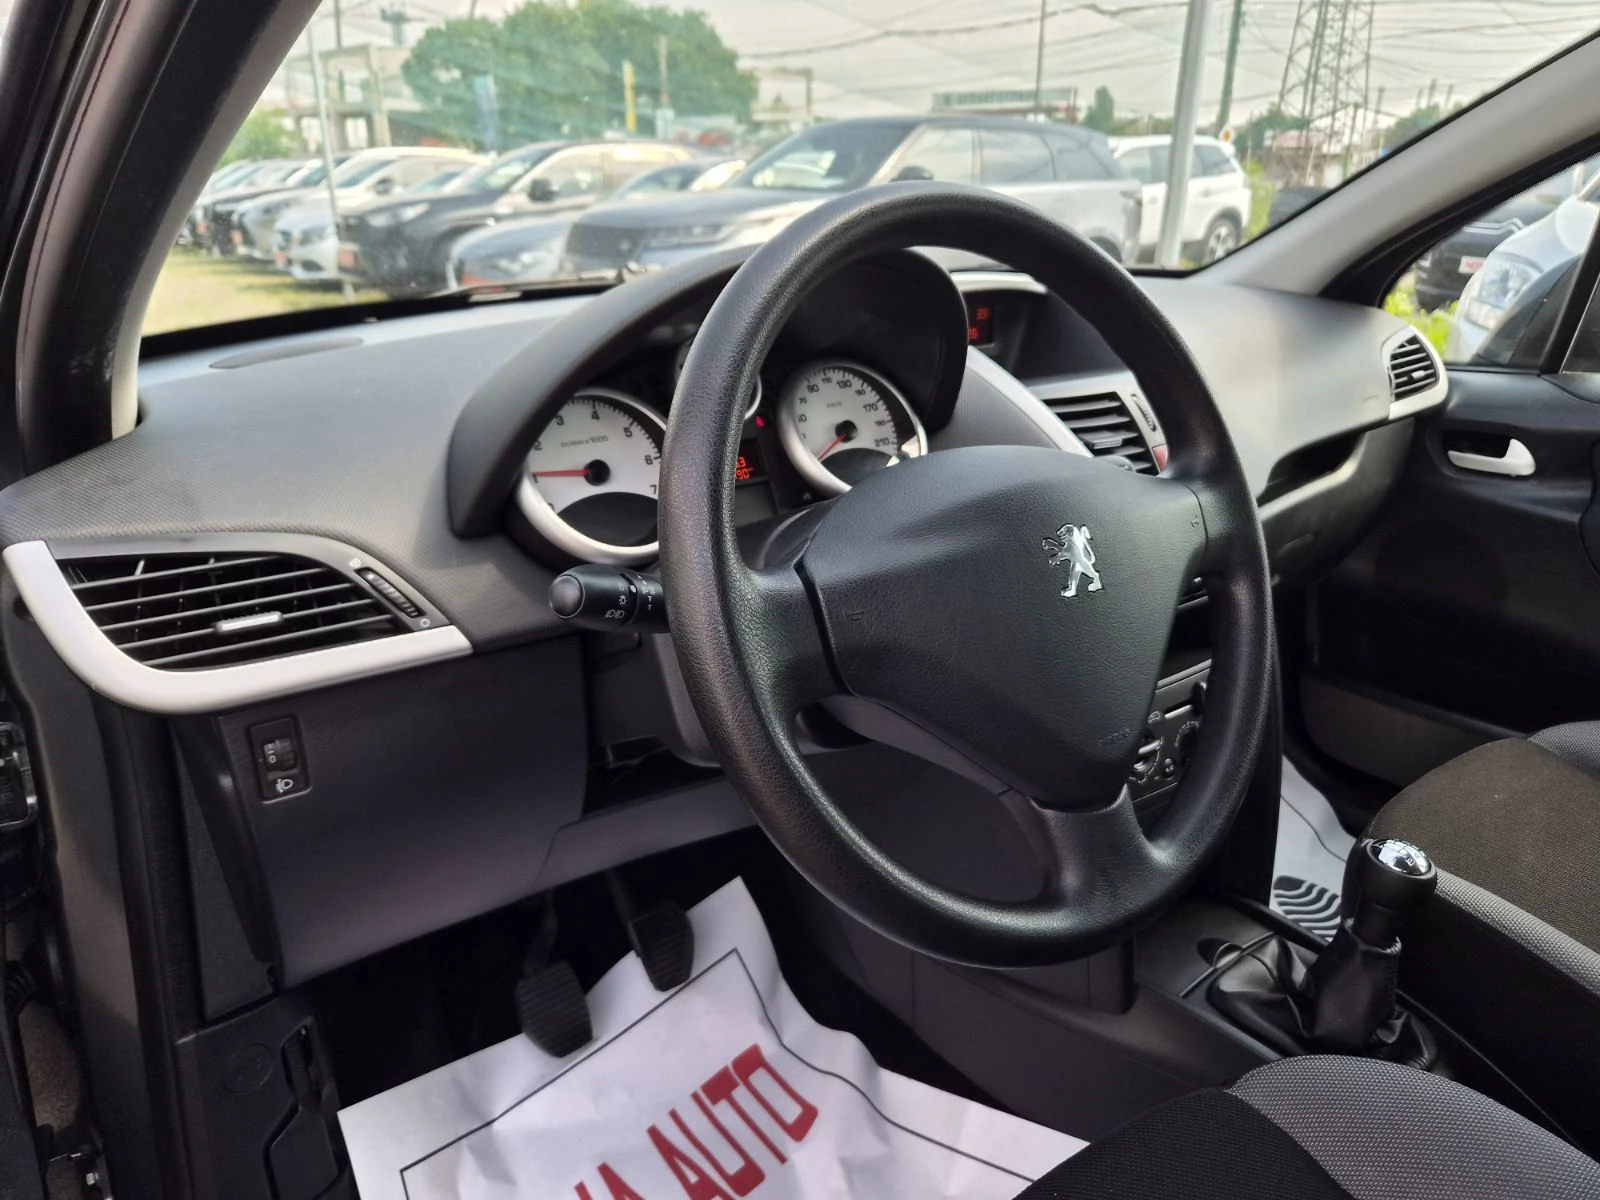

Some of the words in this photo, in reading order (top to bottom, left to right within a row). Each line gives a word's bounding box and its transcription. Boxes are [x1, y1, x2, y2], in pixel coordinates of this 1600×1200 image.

[807, 384, 819, 393] 90
[837, 379, 852, 389] 130
[863, 403, 878, 413] 170
[556, 415, 564, 425] 3
[592, 411, 599, 420] 4
[624, 427, 632, 437] 5
[534, 441, 543, 450] 2
[874, 438, 890, 448] 210
[645, 455, 653, 465] 6
[650, 484, 657, 495] 7
[646, 1043, 819, 1200] AUTO
